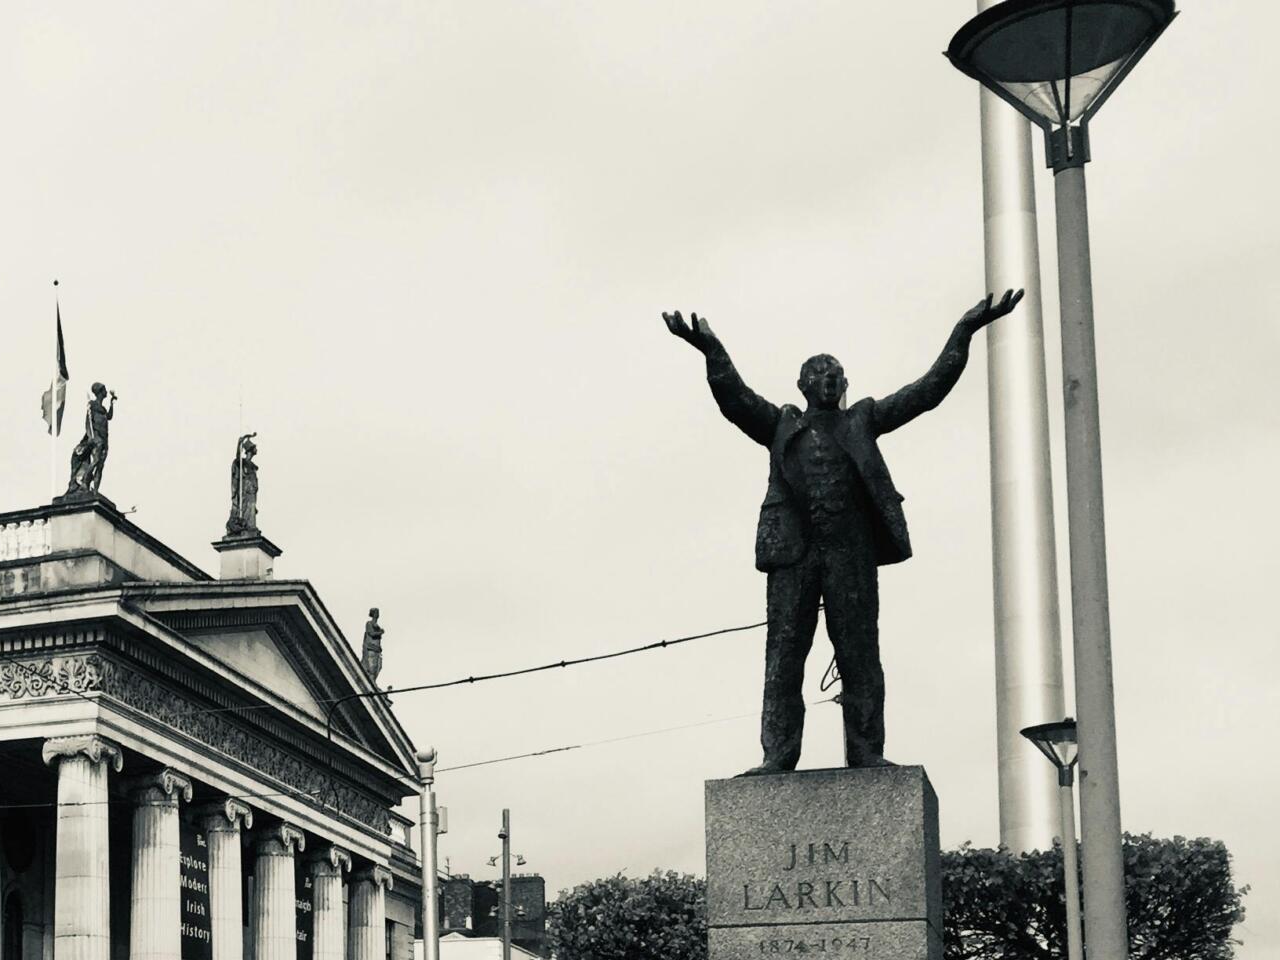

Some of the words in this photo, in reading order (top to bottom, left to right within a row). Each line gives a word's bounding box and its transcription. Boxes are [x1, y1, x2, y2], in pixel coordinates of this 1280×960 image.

[783, 842, 850, 871] JIM
[186, 899, 206, 916] Irish
[743, 879, 893, 911] LARKIN
[180, 922, 211, 943] History
